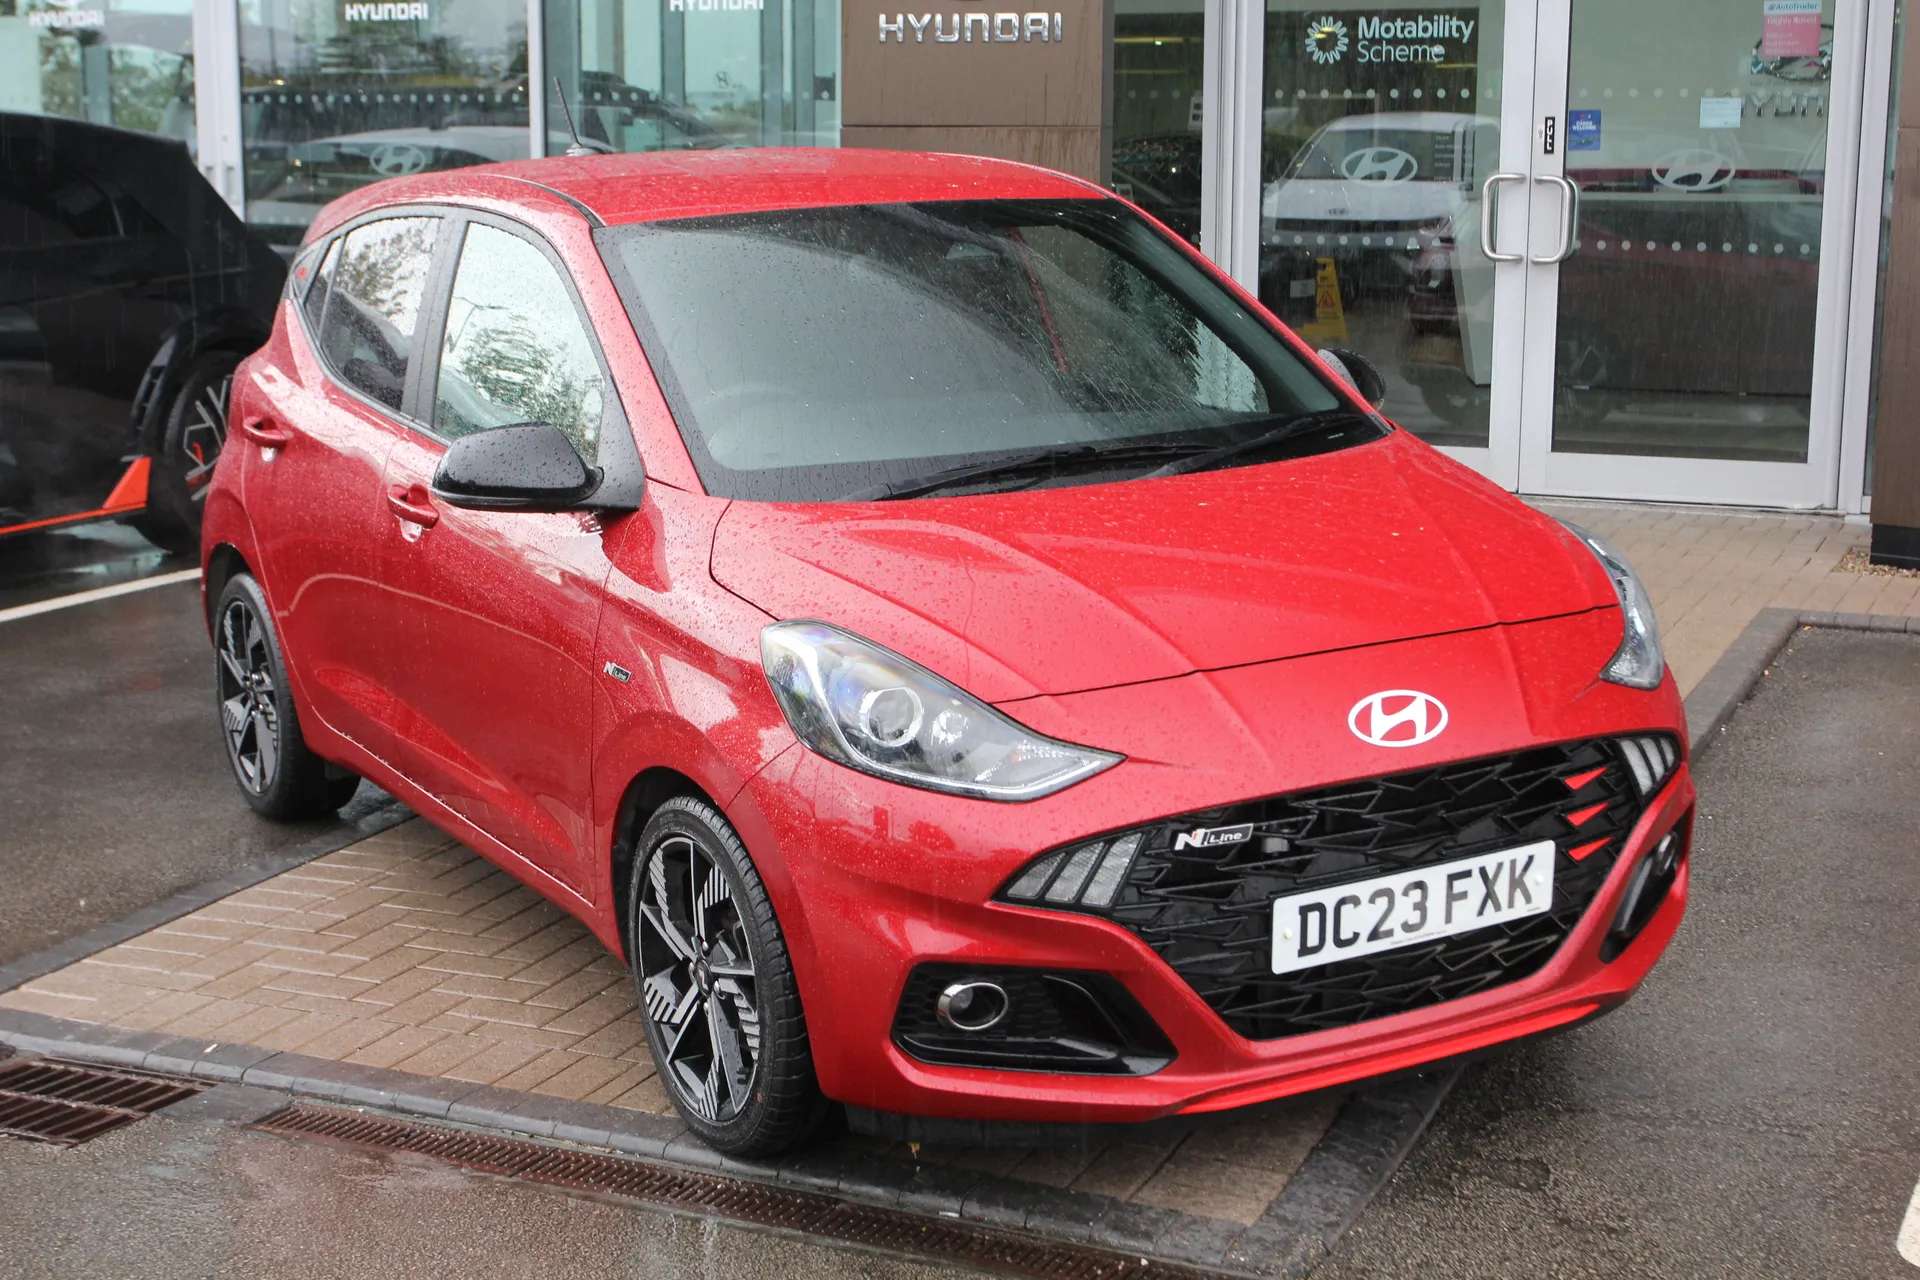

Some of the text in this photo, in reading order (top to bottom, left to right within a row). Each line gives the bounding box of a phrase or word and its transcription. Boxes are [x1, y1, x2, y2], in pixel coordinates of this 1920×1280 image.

[345, 2, 429, 21] HYUNDAI
[878, 12, 1062, 43] HYUNDAI
[1358, 15, 1475, 43] Motability
[1357, 41, 1446, 63] Scheme
[1546, 119, 1554, 151] PULL
[1297, 853, 1535, 959] DC23 FXK
